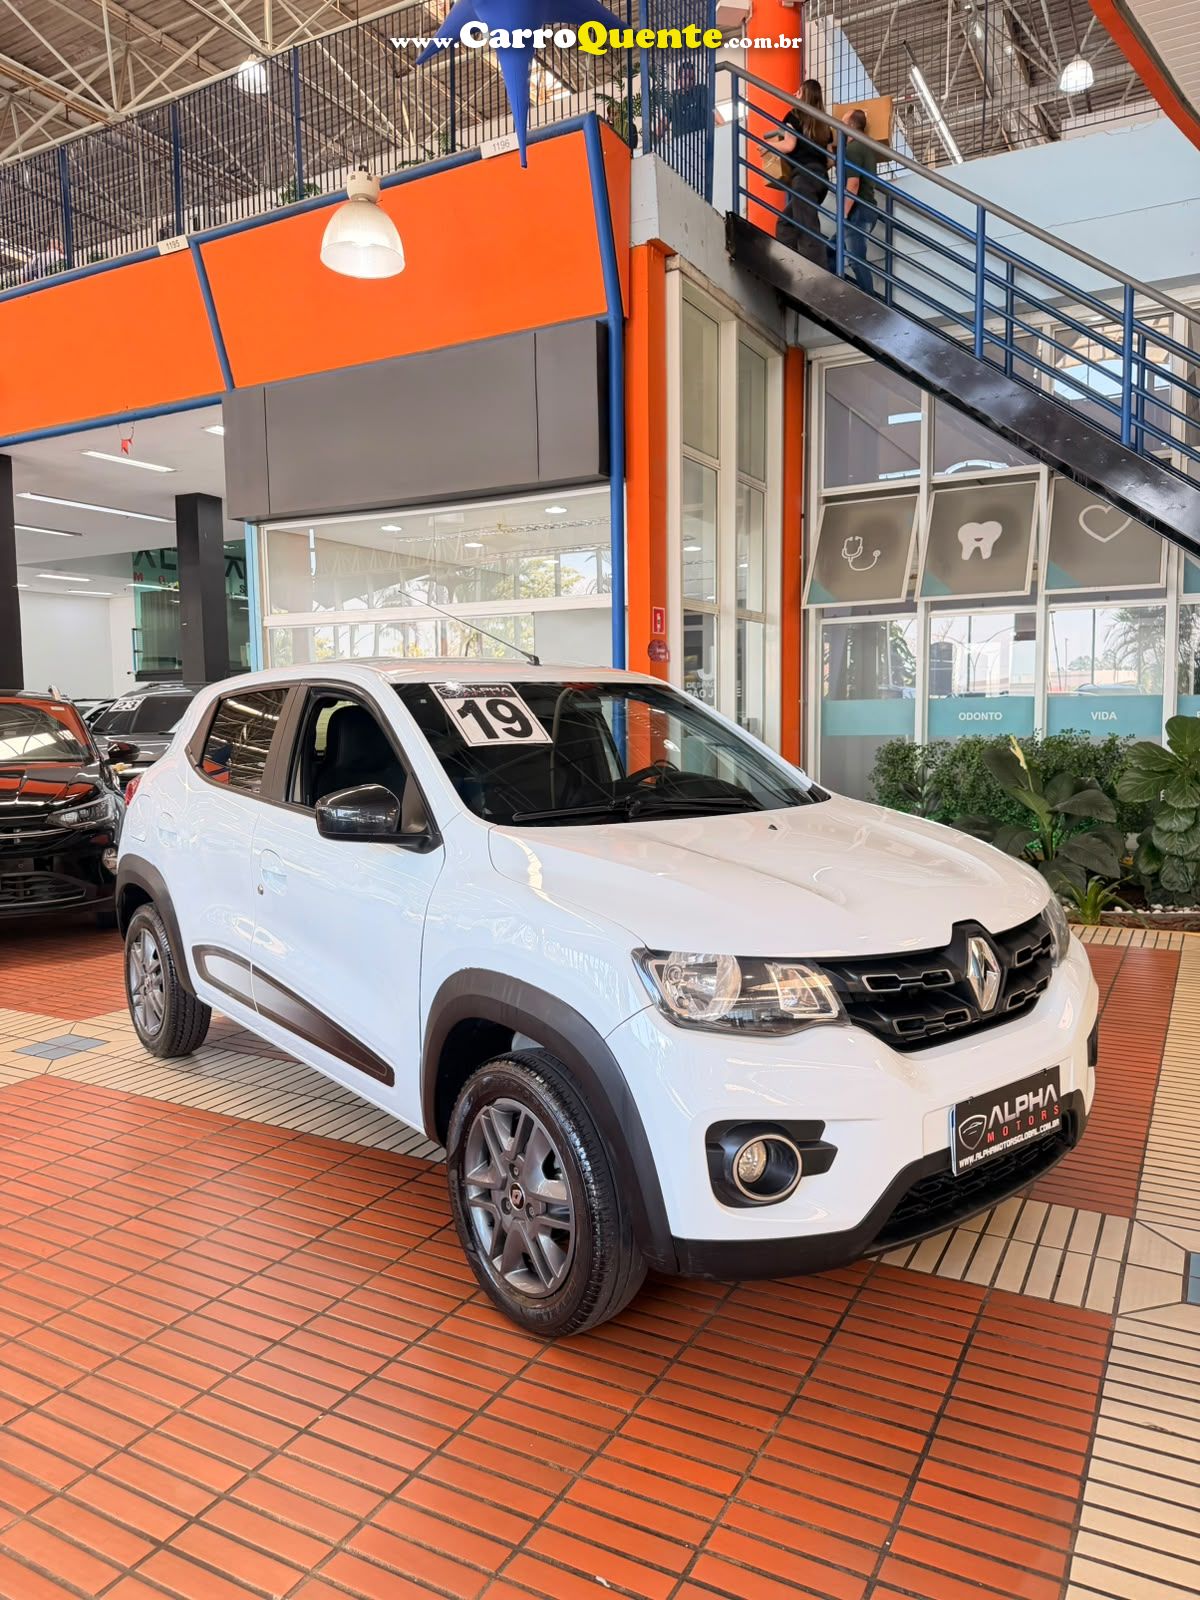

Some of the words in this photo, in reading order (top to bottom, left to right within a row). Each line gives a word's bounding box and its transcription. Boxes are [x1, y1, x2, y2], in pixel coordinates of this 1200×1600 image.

[492, 139, 511, 152] 1196
[166, 239, 181, 251] 1195
[133, 548, 244, 580] ALA
[113, 701, 138, 710] 23
[456, 698, 534, 740] 19
[958, 711, 1003, 721] ODONTO
[1090, 711, 1118, 721] VIDA
[988, 1083, 1058, 1130] ALPHA
[987, 1104, 1061, 1143] MOTORS
